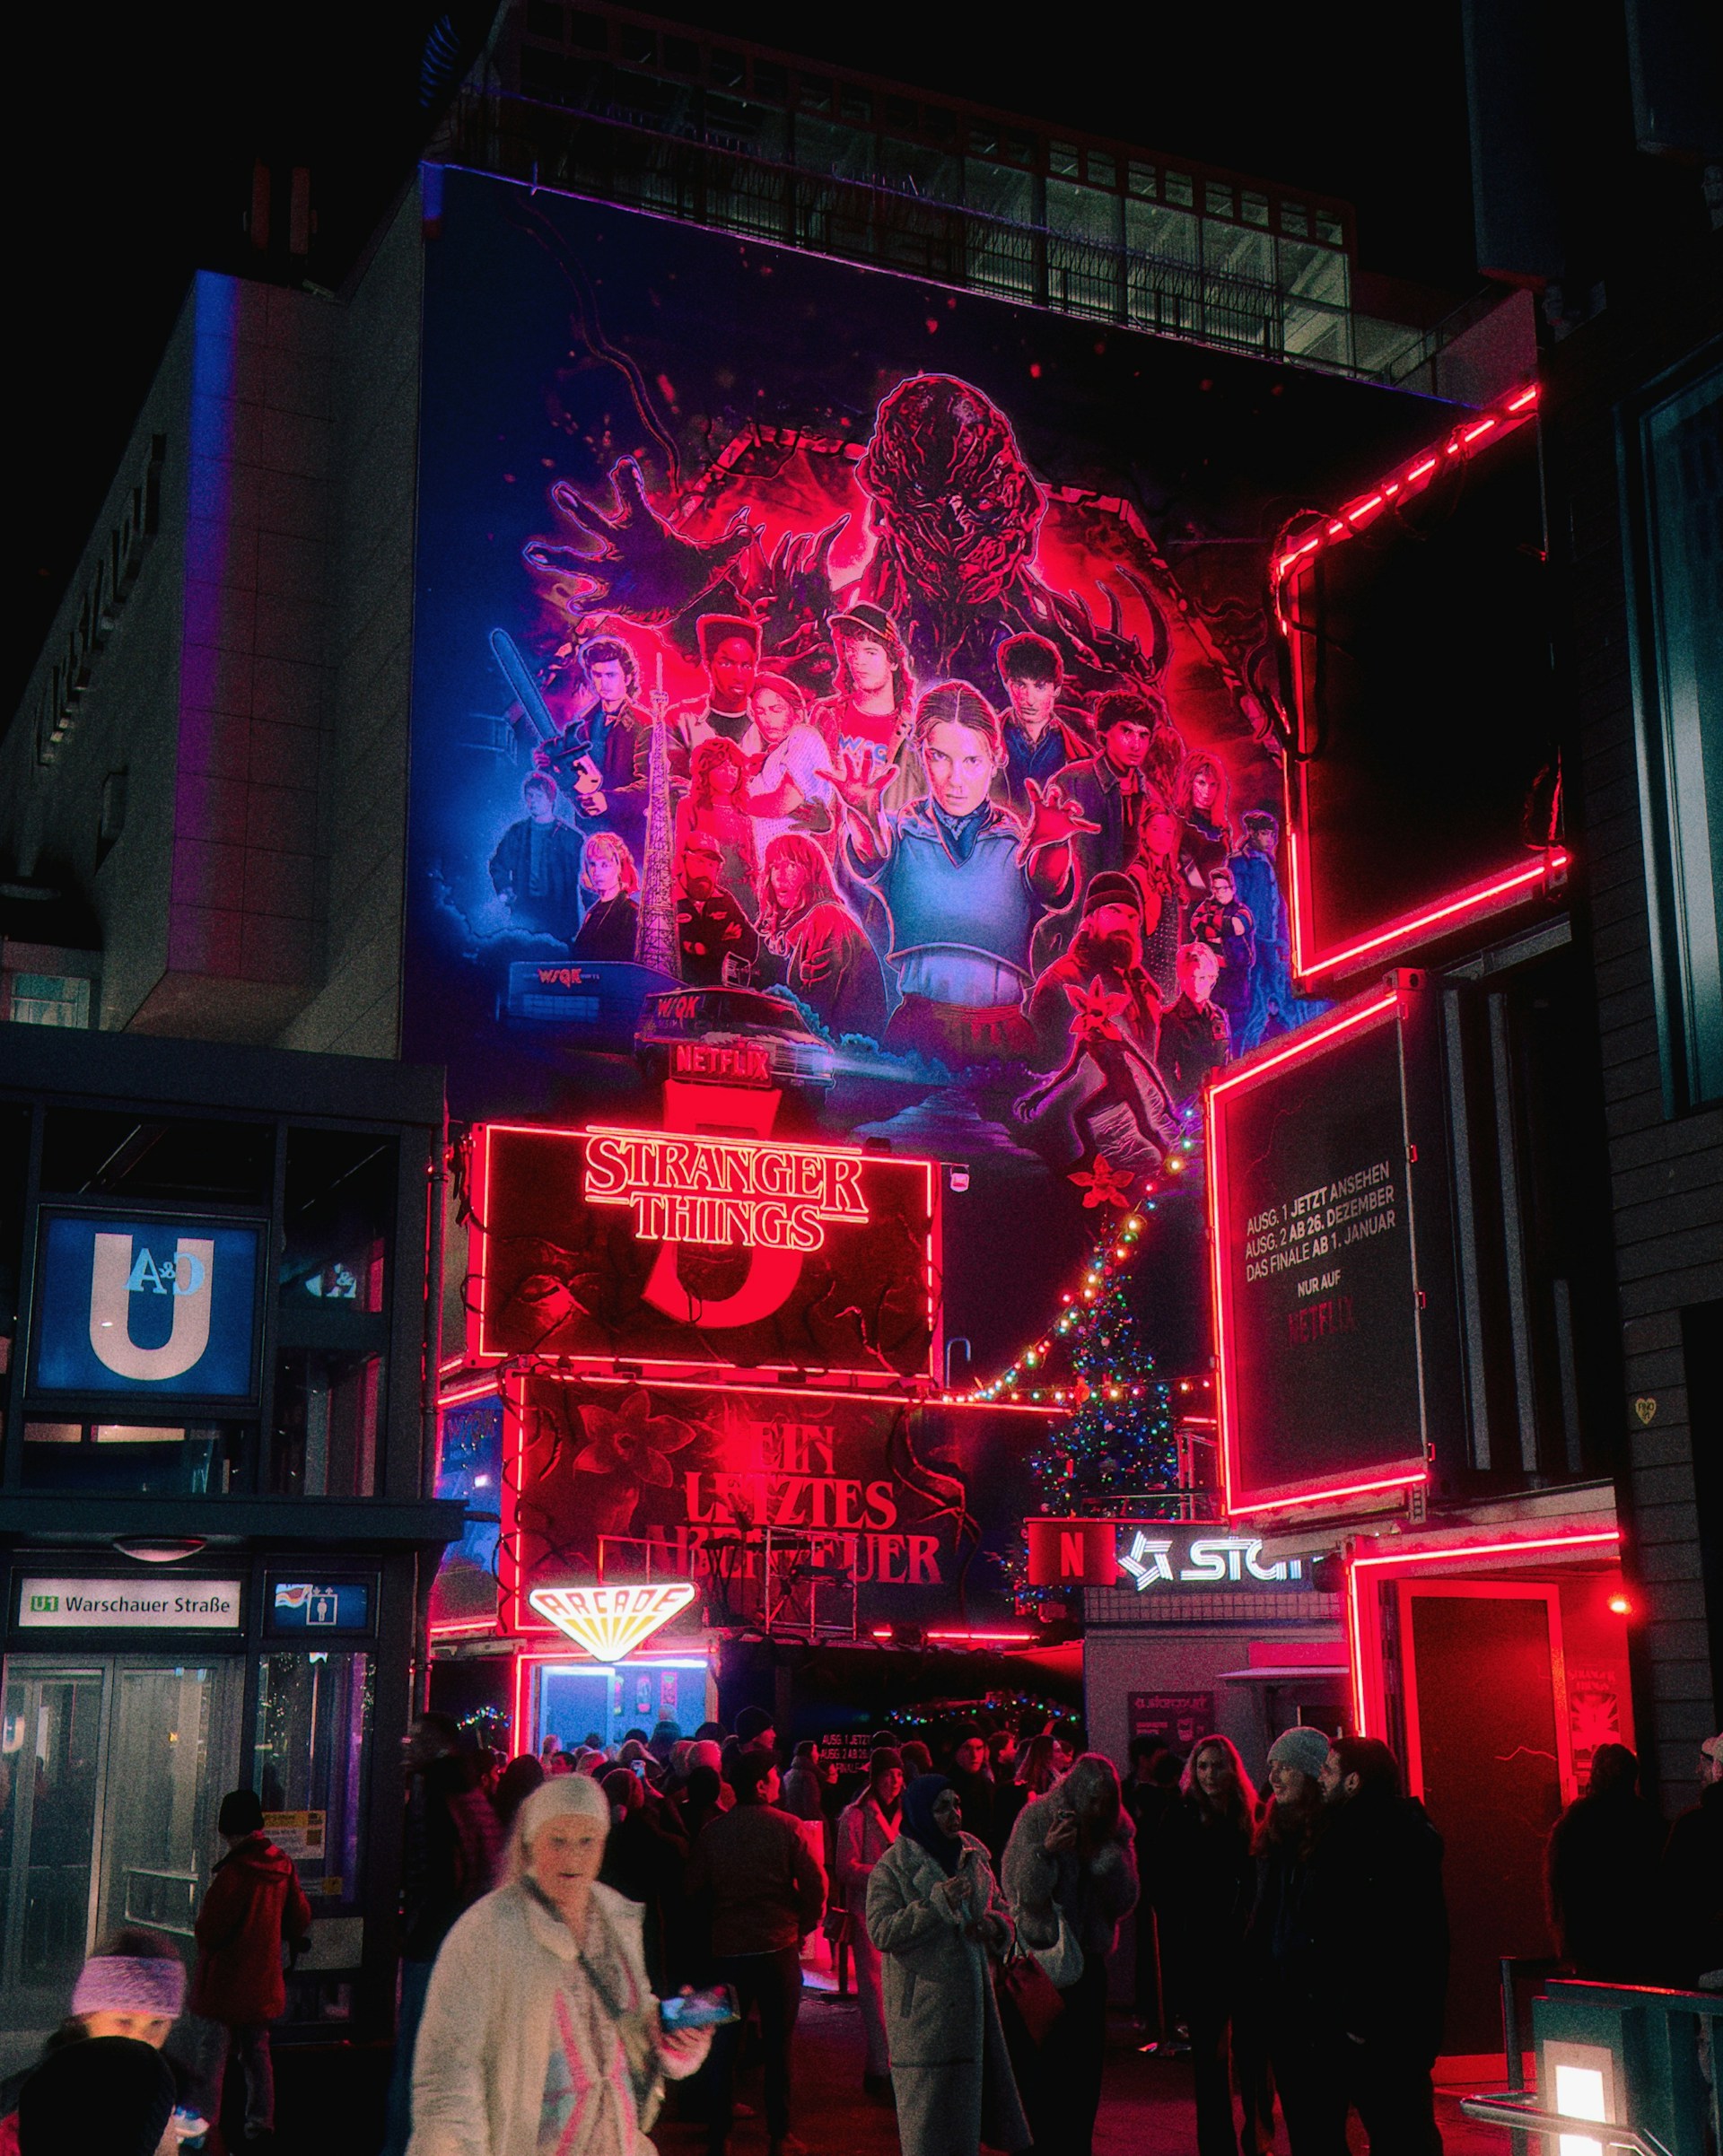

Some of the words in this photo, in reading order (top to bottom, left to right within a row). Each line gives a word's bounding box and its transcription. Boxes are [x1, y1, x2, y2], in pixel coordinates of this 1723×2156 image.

[676, 1044, 770, 1081] NETFLIX
[585, 1135, 869, 1214] STRANGER
[1246, 1210, 1280, 1236] AUSG.
[1282, 1204, 1288, 1220] 1
[1290, 1186, 1328, 1218] JETZT
[1330, 1160, 1390, 1202] ANSEHEN
[629, 1196, 826, 1251] THINGS
[1246, 1235, 1279, 1261] AUSG.
[1280, 1229, 1288, 1245] 2
[1289, 1221, 1307, 1243] AB
[1307, 1215, 1325, 1235] 26.
[1326, 1185, 1395, 1228] DEZEMBER
[1246, 1261, 1268, 1282] DAS
[1270, 1243, 1310, 1274] FINALE
[1312, 1237, 1329, 1258] AB
[1331, 1233, 1342, 1251] 1.
[1344, 1209, 1396, 1246] JANUAR
[89, 1232, 214, 1381] U
[1298, 1277, 1319, 1297] NUR
[1320, 1270, 1342, 1289] AUF
[749, 1420, 835, 1475] EIN
[685, 1471, 896, 1531] LETZTES
[1061, 1532, 1084, 1577] N
[33, 1596, 57, 1611] U1
[66, 1595, 170, 1613] Warschauer
[174, 1596, 231, 1614] Straße
[535, 1586, 690, 1616] ARCADE
